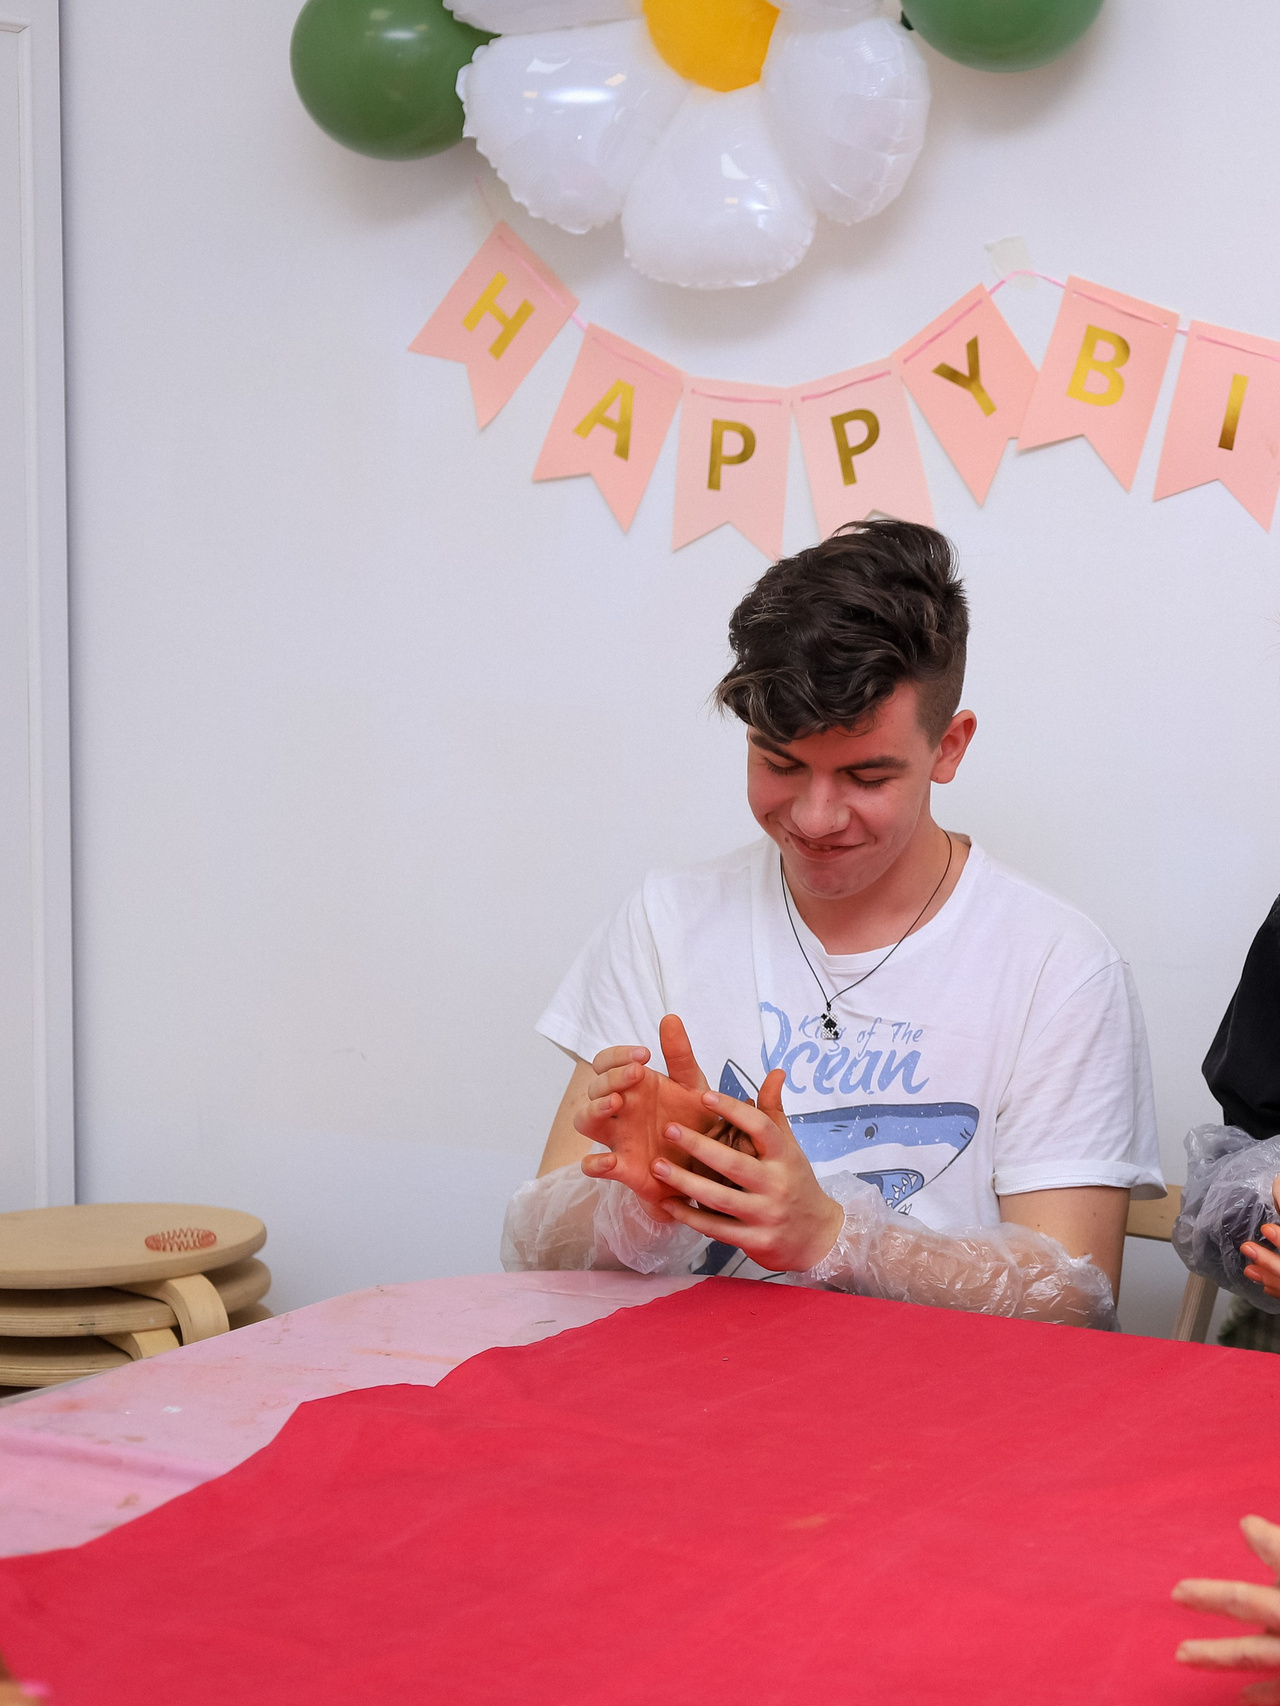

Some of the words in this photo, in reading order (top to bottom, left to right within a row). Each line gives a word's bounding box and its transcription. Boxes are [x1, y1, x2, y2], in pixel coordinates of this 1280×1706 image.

[461, 271, 997, 492] HAPPY
[798, 1014, 847, 1052] Kig
[856, 1017, 883, 1058] of
[892, 1021, 924, 1043] The
